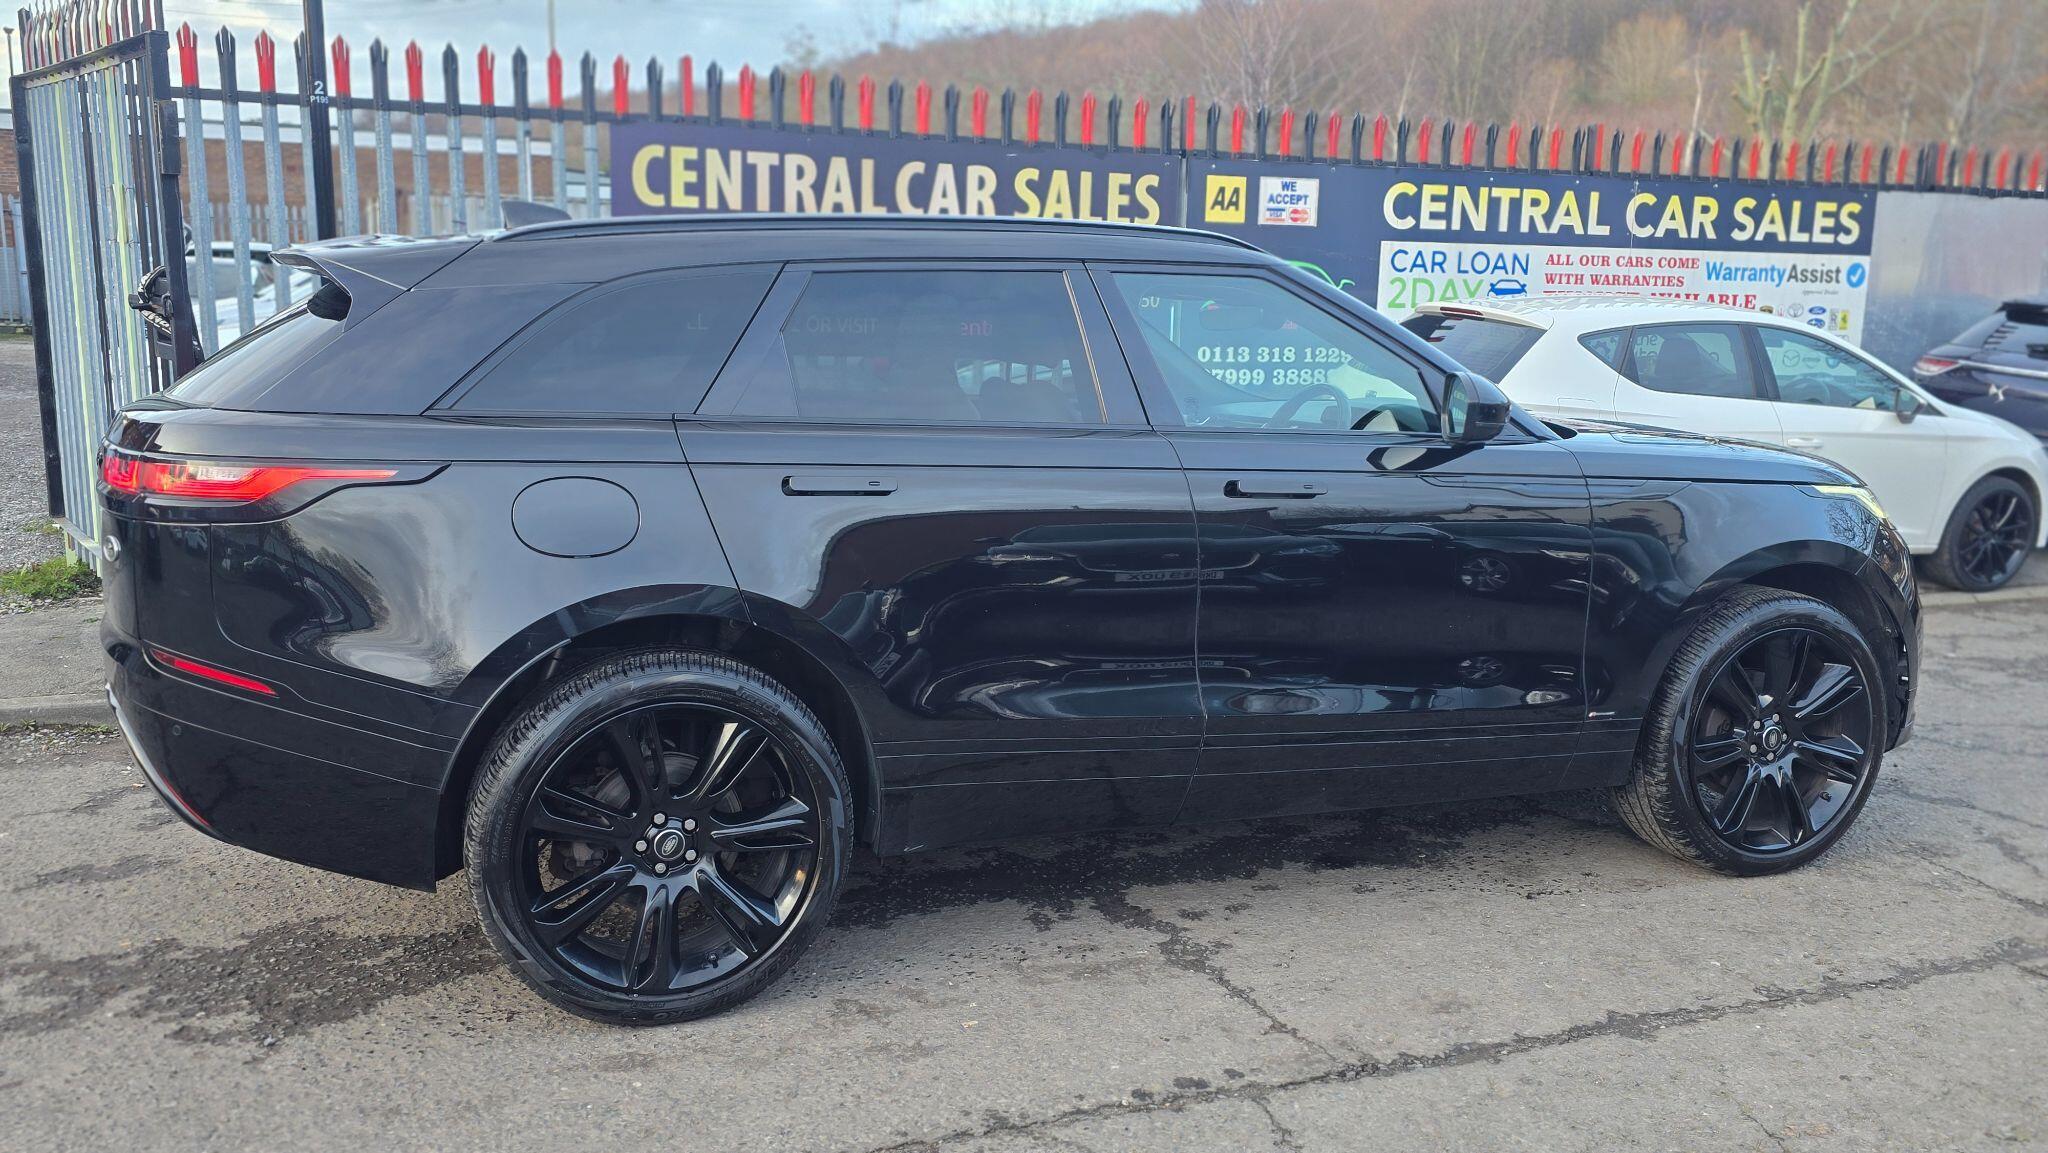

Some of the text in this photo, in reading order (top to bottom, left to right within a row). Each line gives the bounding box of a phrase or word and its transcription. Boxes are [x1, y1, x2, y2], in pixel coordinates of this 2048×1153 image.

[313, 80, 325, 95] 2
[631, 143, 1161, 226] CENTRAL CAR SALES
[1280, 181, 1298, 192] WE
[1210, 186, 1241, 212] AA
[1267, 193, 1310, 206] ACCEPT
[1382, 181, 1863, 245] CENTRAL CAR SALES
[1390, 248, 1530, 276] CAR LOAN
[1545, 253, 1700, 269] ALL OUR CARS COME
[1544, 272, 1685, 288] WITH WARRANTIES
[1197, 346, 1251, 363] 0113
[1256, 346, 1296, 363] 318
